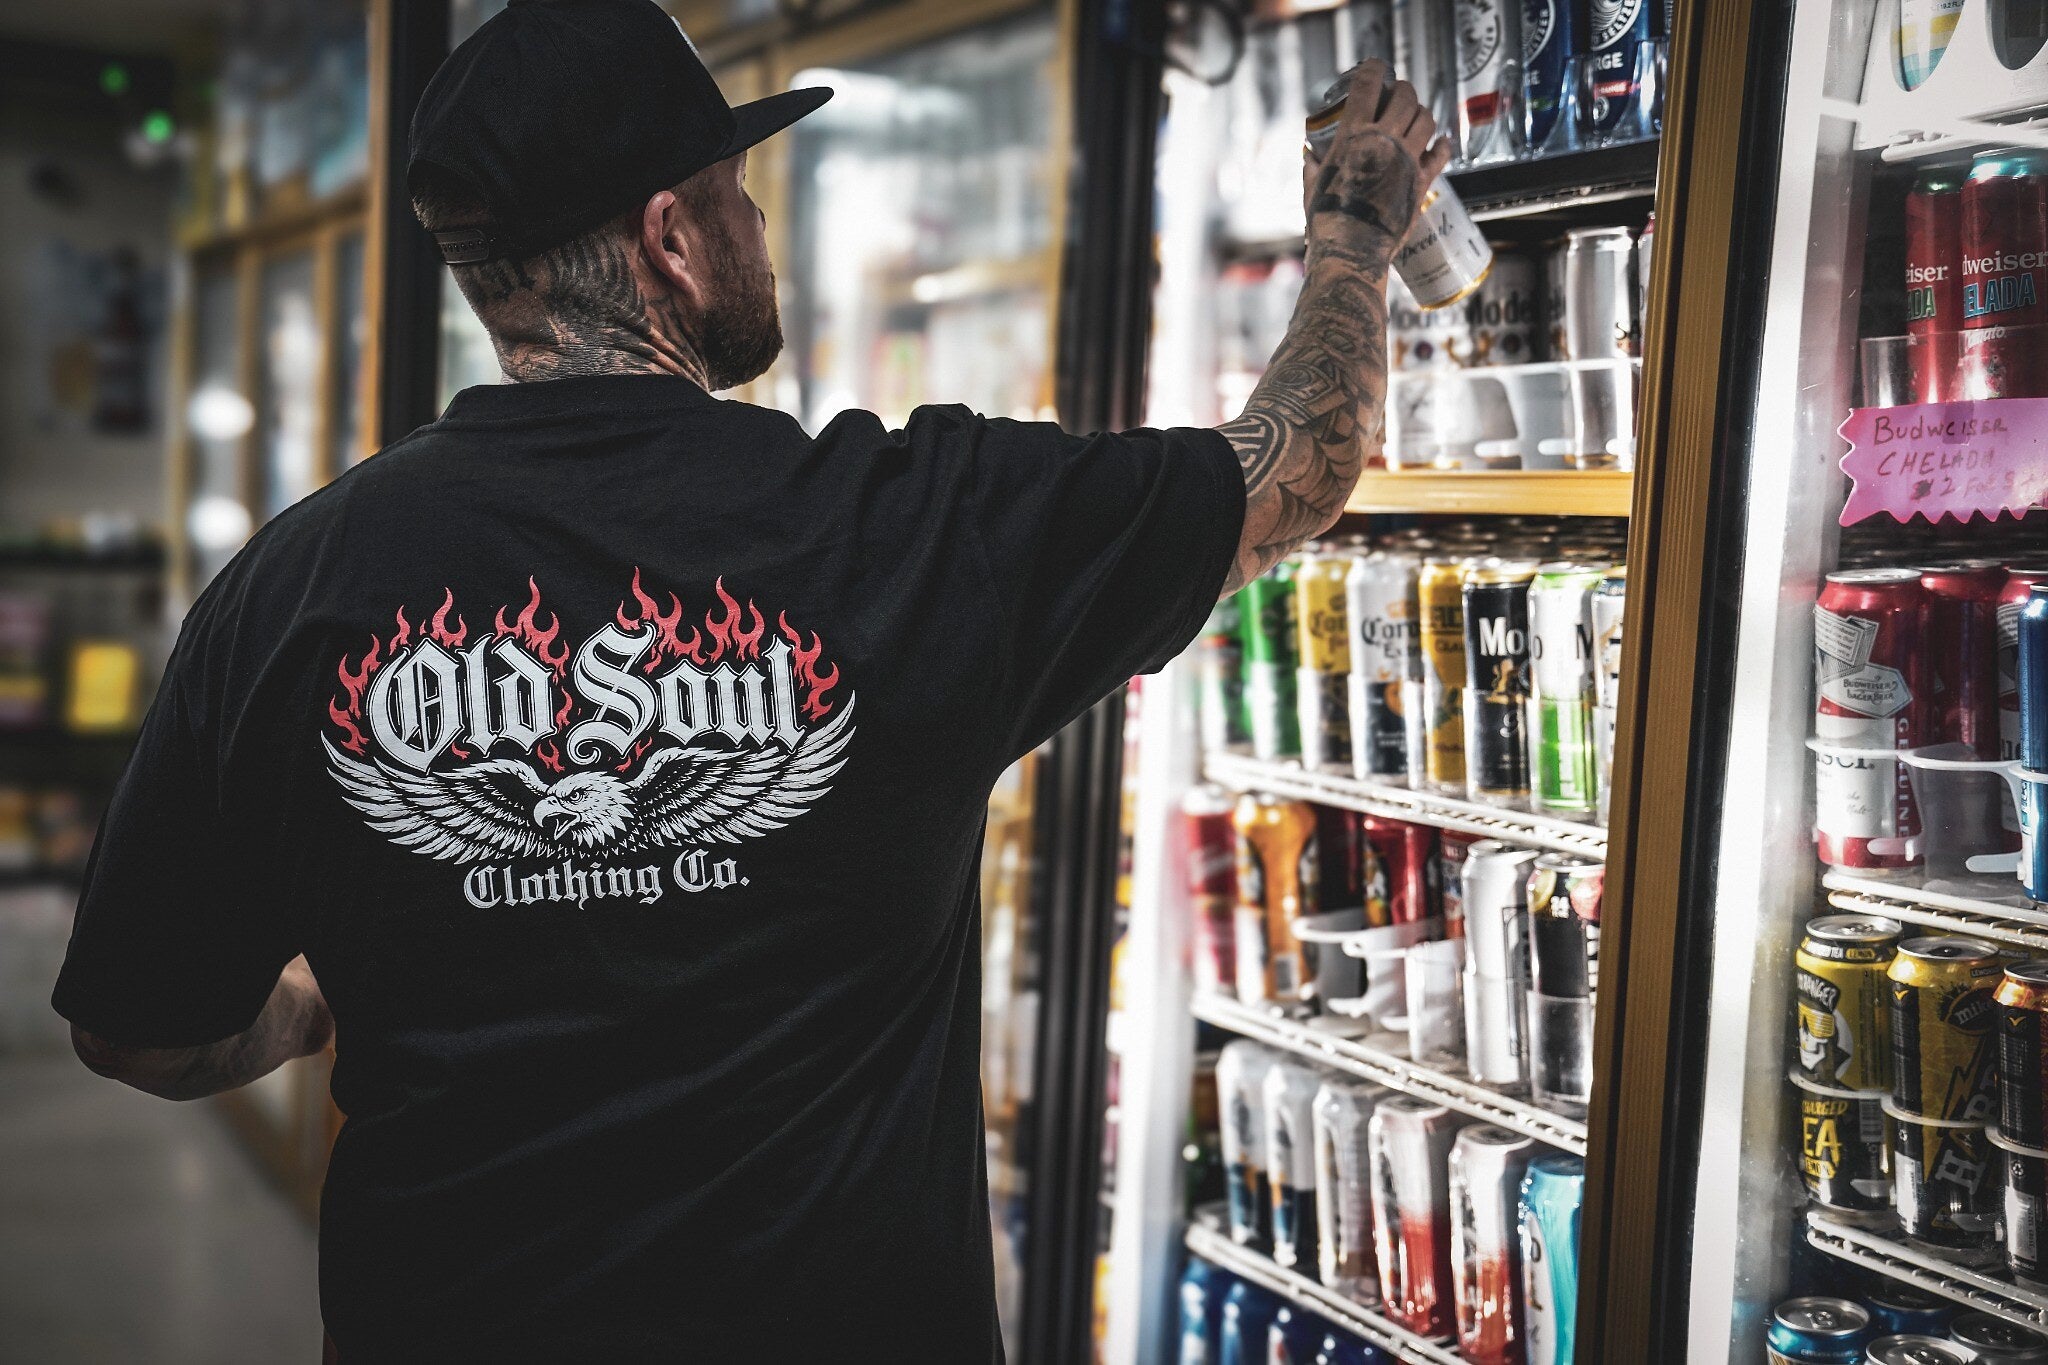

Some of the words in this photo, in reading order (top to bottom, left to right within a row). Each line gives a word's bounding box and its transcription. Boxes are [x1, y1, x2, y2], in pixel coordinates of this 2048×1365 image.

[366, 632, 556, 774] Old
[566, 621, 807, 766] Soul
[463, 860, 662, 911] Clothing
[672, 849, 750, 893] Co.
